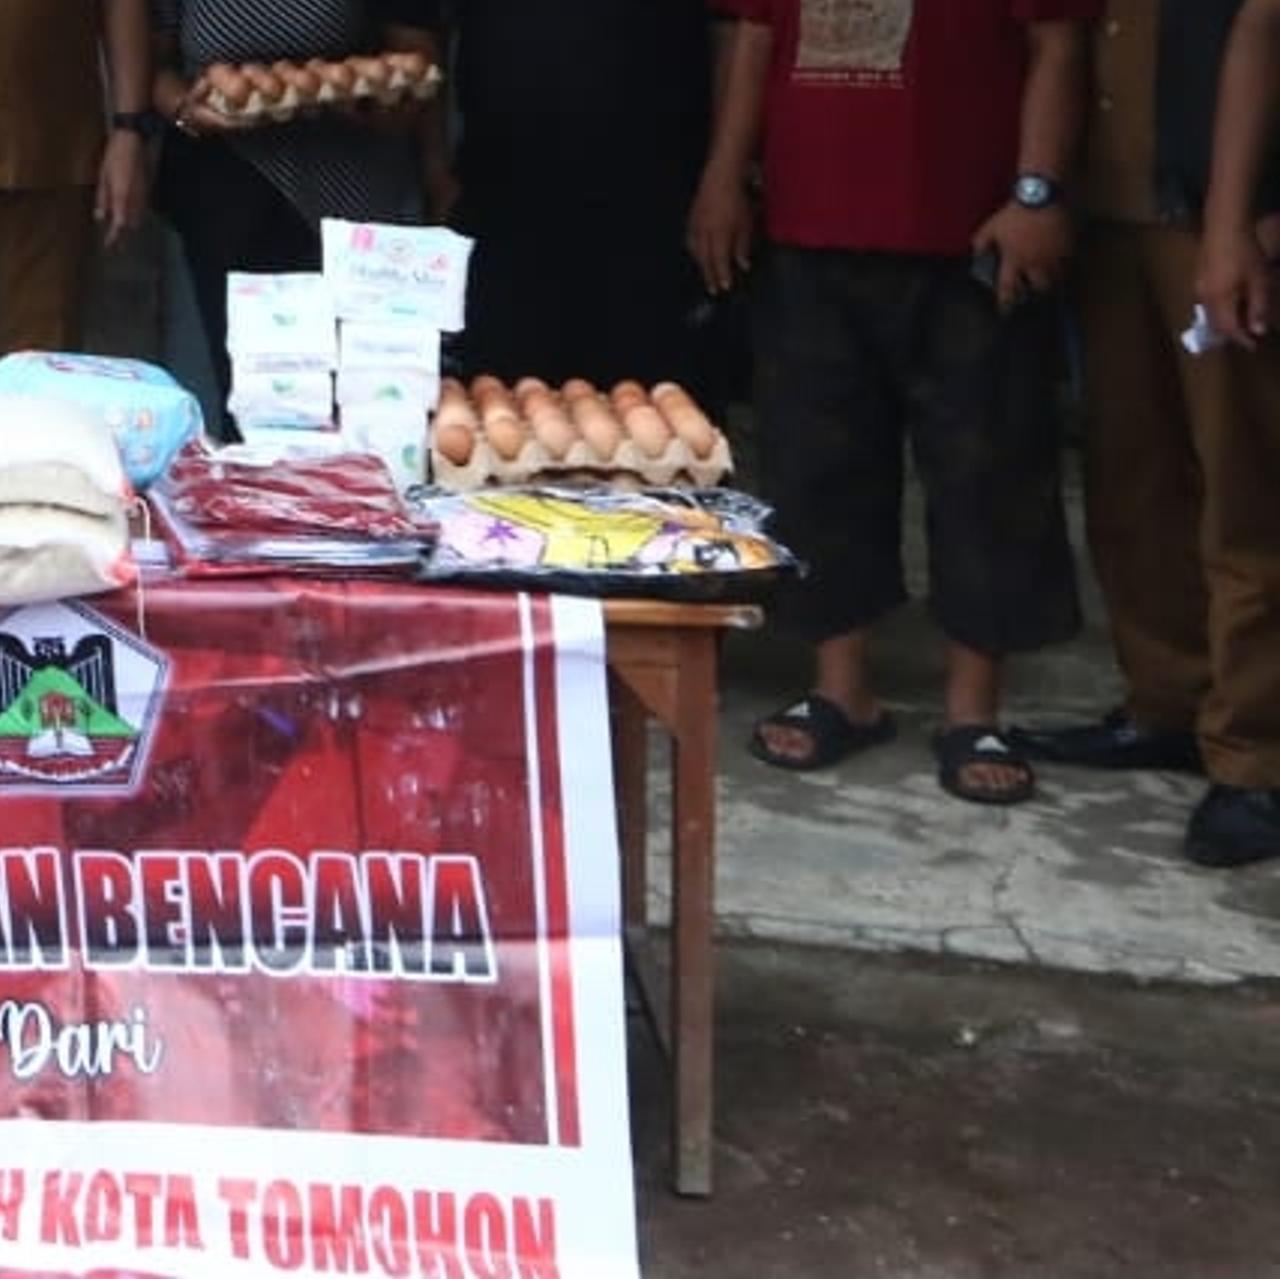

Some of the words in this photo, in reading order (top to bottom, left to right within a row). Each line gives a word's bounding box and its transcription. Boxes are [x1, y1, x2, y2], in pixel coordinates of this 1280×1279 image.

[74, 850, 497, 982] BENCANA
[40, 1168, 205, 1250] KOTA
[217, 1177, 562, 1279] TOMOHON
